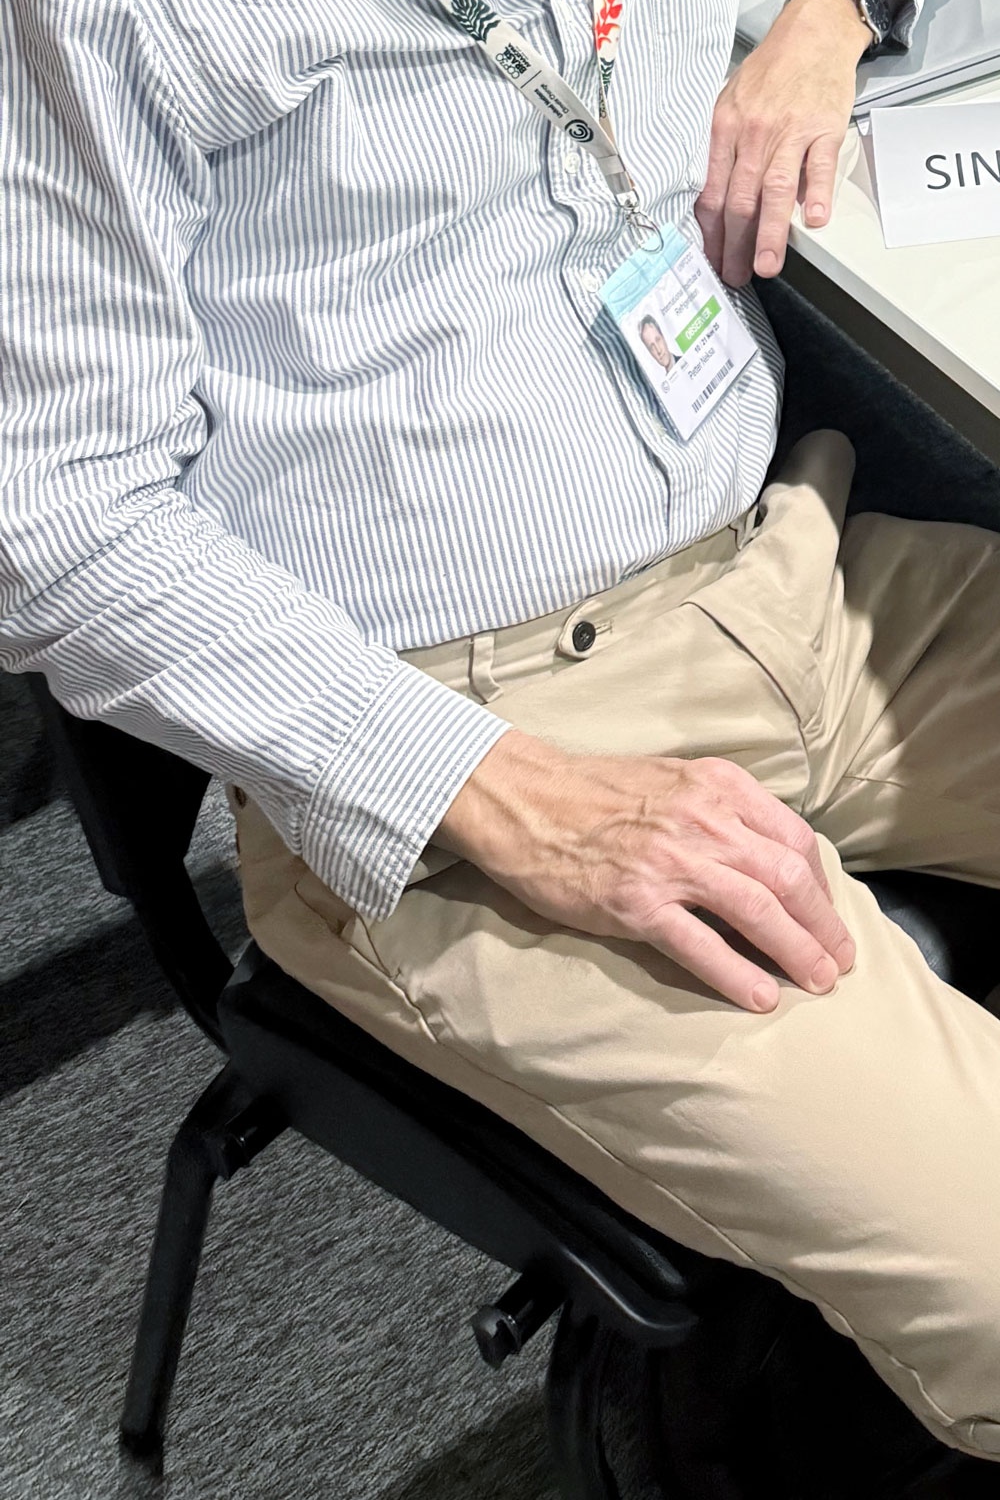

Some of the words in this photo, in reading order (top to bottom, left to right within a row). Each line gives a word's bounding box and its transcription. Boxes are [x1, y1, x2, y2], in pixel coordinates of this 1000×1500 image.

[496, 53, 520, 79] COP30
[503, 46, 527, 74] BRASIL
[534, 89, 550, 106] Nations
[541, 84, 555, 100] Change
[549, 104, 563, 118] United
[686, 308, 713, 340] OBSERVER
